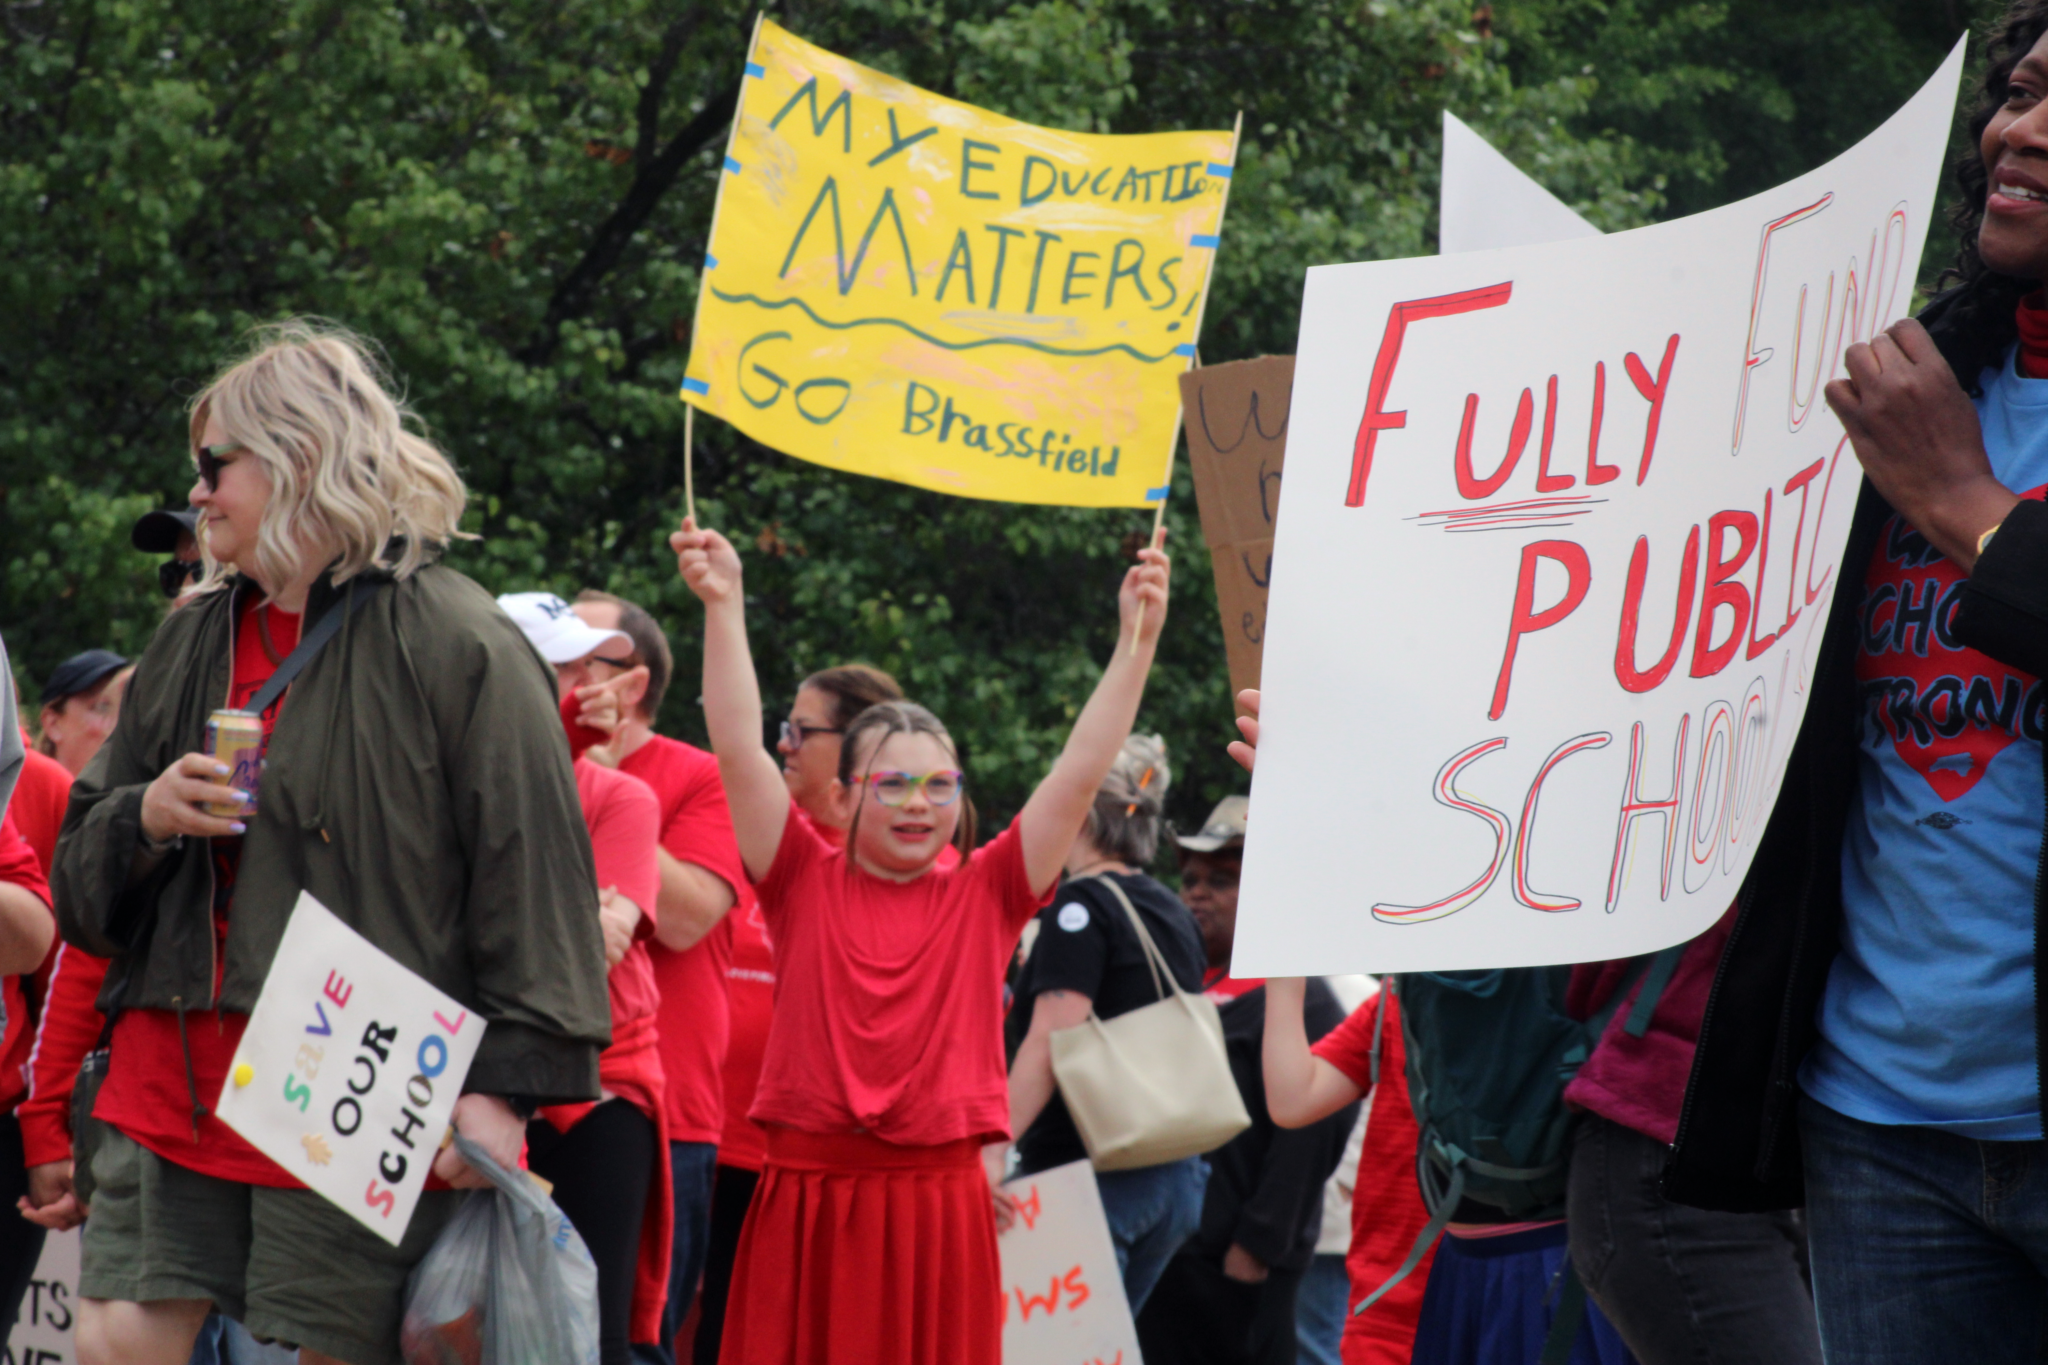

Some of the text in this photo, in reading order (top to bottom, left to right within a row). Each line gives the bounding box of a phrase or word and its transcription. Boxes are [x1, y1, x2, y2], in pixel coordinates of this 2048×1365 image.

[769, 76, 938, 168] MY
[778, 175, 1199, 333] MATTERS!
[737, 330, 852, 425] GO
[900, 380, 1119, 477] Brassfield
[1345, 190, 1909, 507] FULLY FUND
[1488, 431, 1850, 720] PUBLIC
[1857, 578, 1970, 658] CHO
[1862, 674, 2046, 750] TRON
[332, 1020, 398, 1137] OUR
[365, 1009, 467, 1219] SCHOOL
